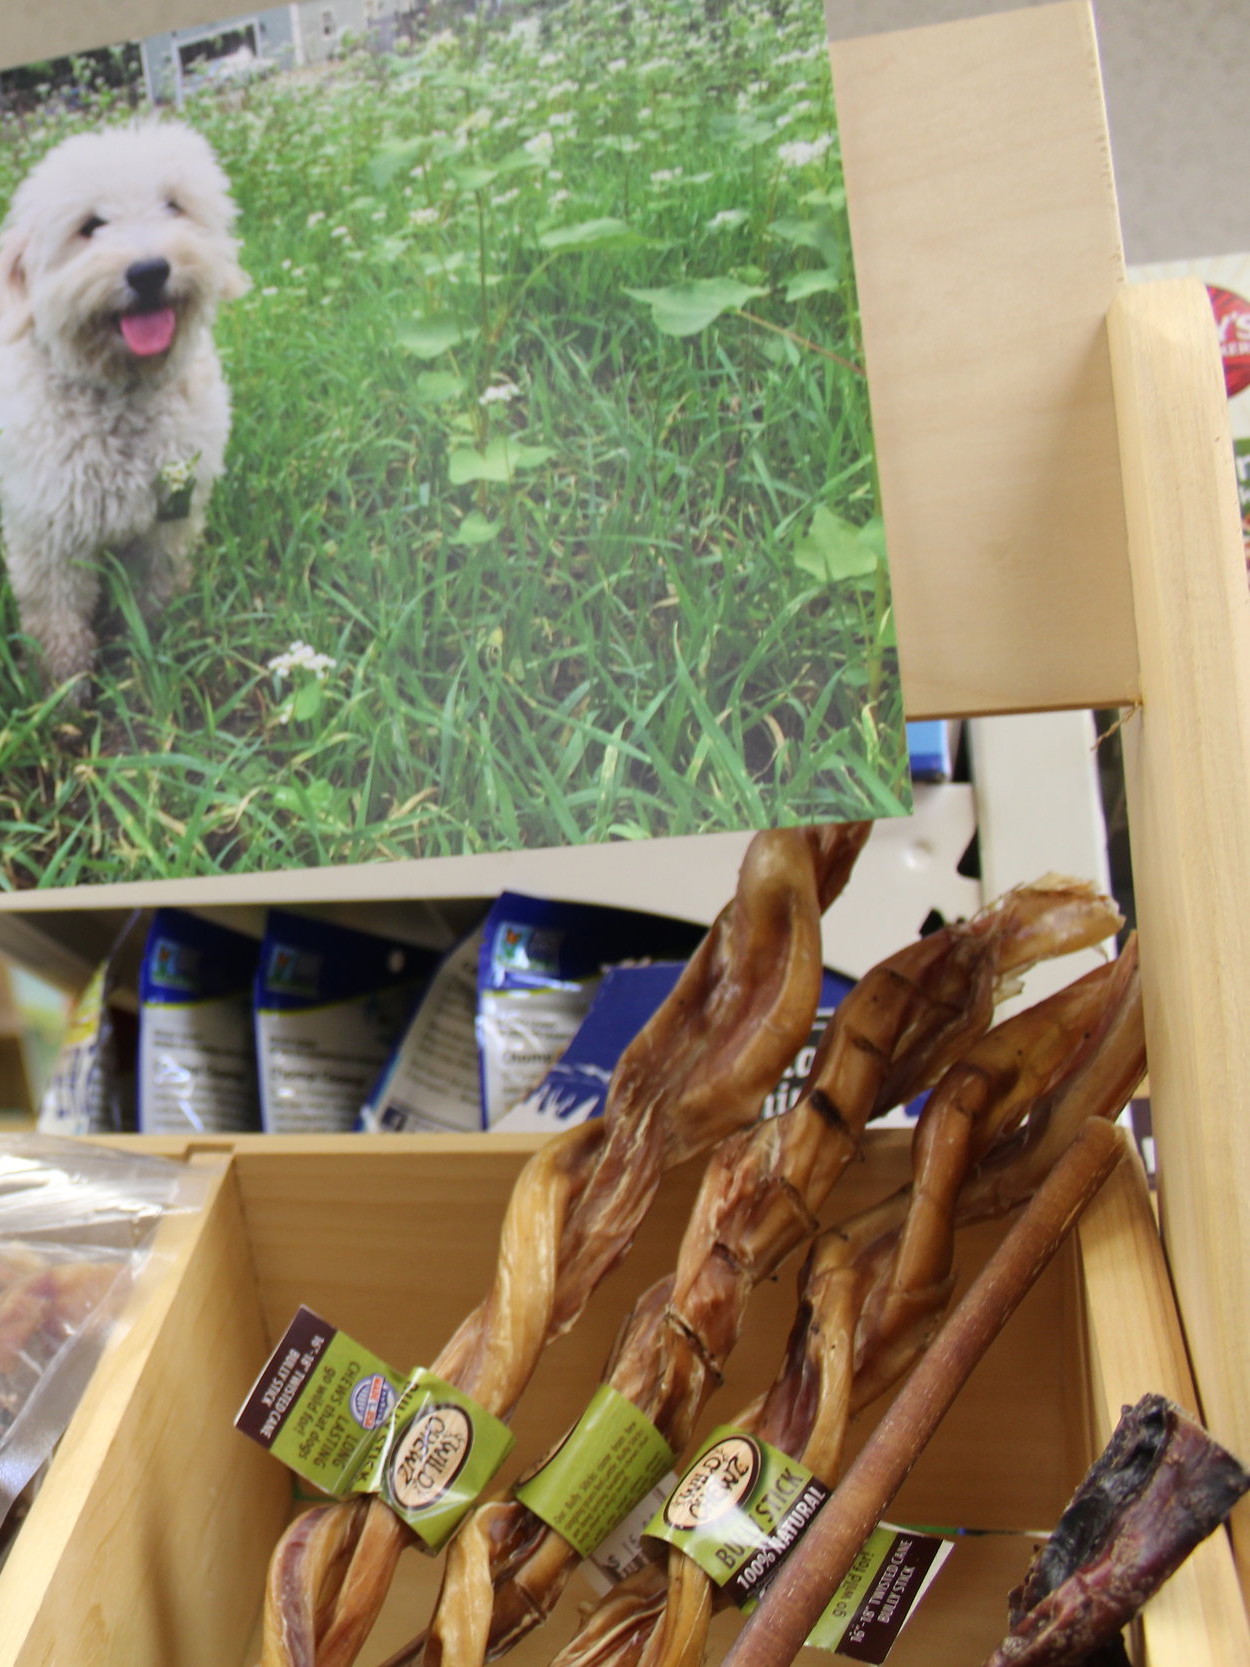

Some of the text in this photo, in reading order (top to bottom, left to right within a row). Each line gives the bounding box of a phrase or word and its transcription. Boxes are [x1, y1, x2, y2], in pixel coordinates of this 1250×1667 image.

[261, 1348, 300, 1407] BULLY STICK
[274, 1369, 304, 1413] TWISTED
[293, 1365, 336, 1435] go wild for!
[259, 1410, 281, 1438] CANE
[295, 1360, 360, 1460] CHEWS that dogs
[313, 1414, 349, 1468] LASTING
[332, 1434, 357, 1469] LONG
[752, 1465, 804, 1523] STICK
[735, 1484, 826, 1592] 100% NATURAL
[838, 1572, 861, 1600] wild
[869, 1562, 898, 1606] TWISTED
[891, 1537, 912, 1565] CANE
[877, 1563, 914, 1624] BULLY STICK
[832, 1600, 849, 1619] go
